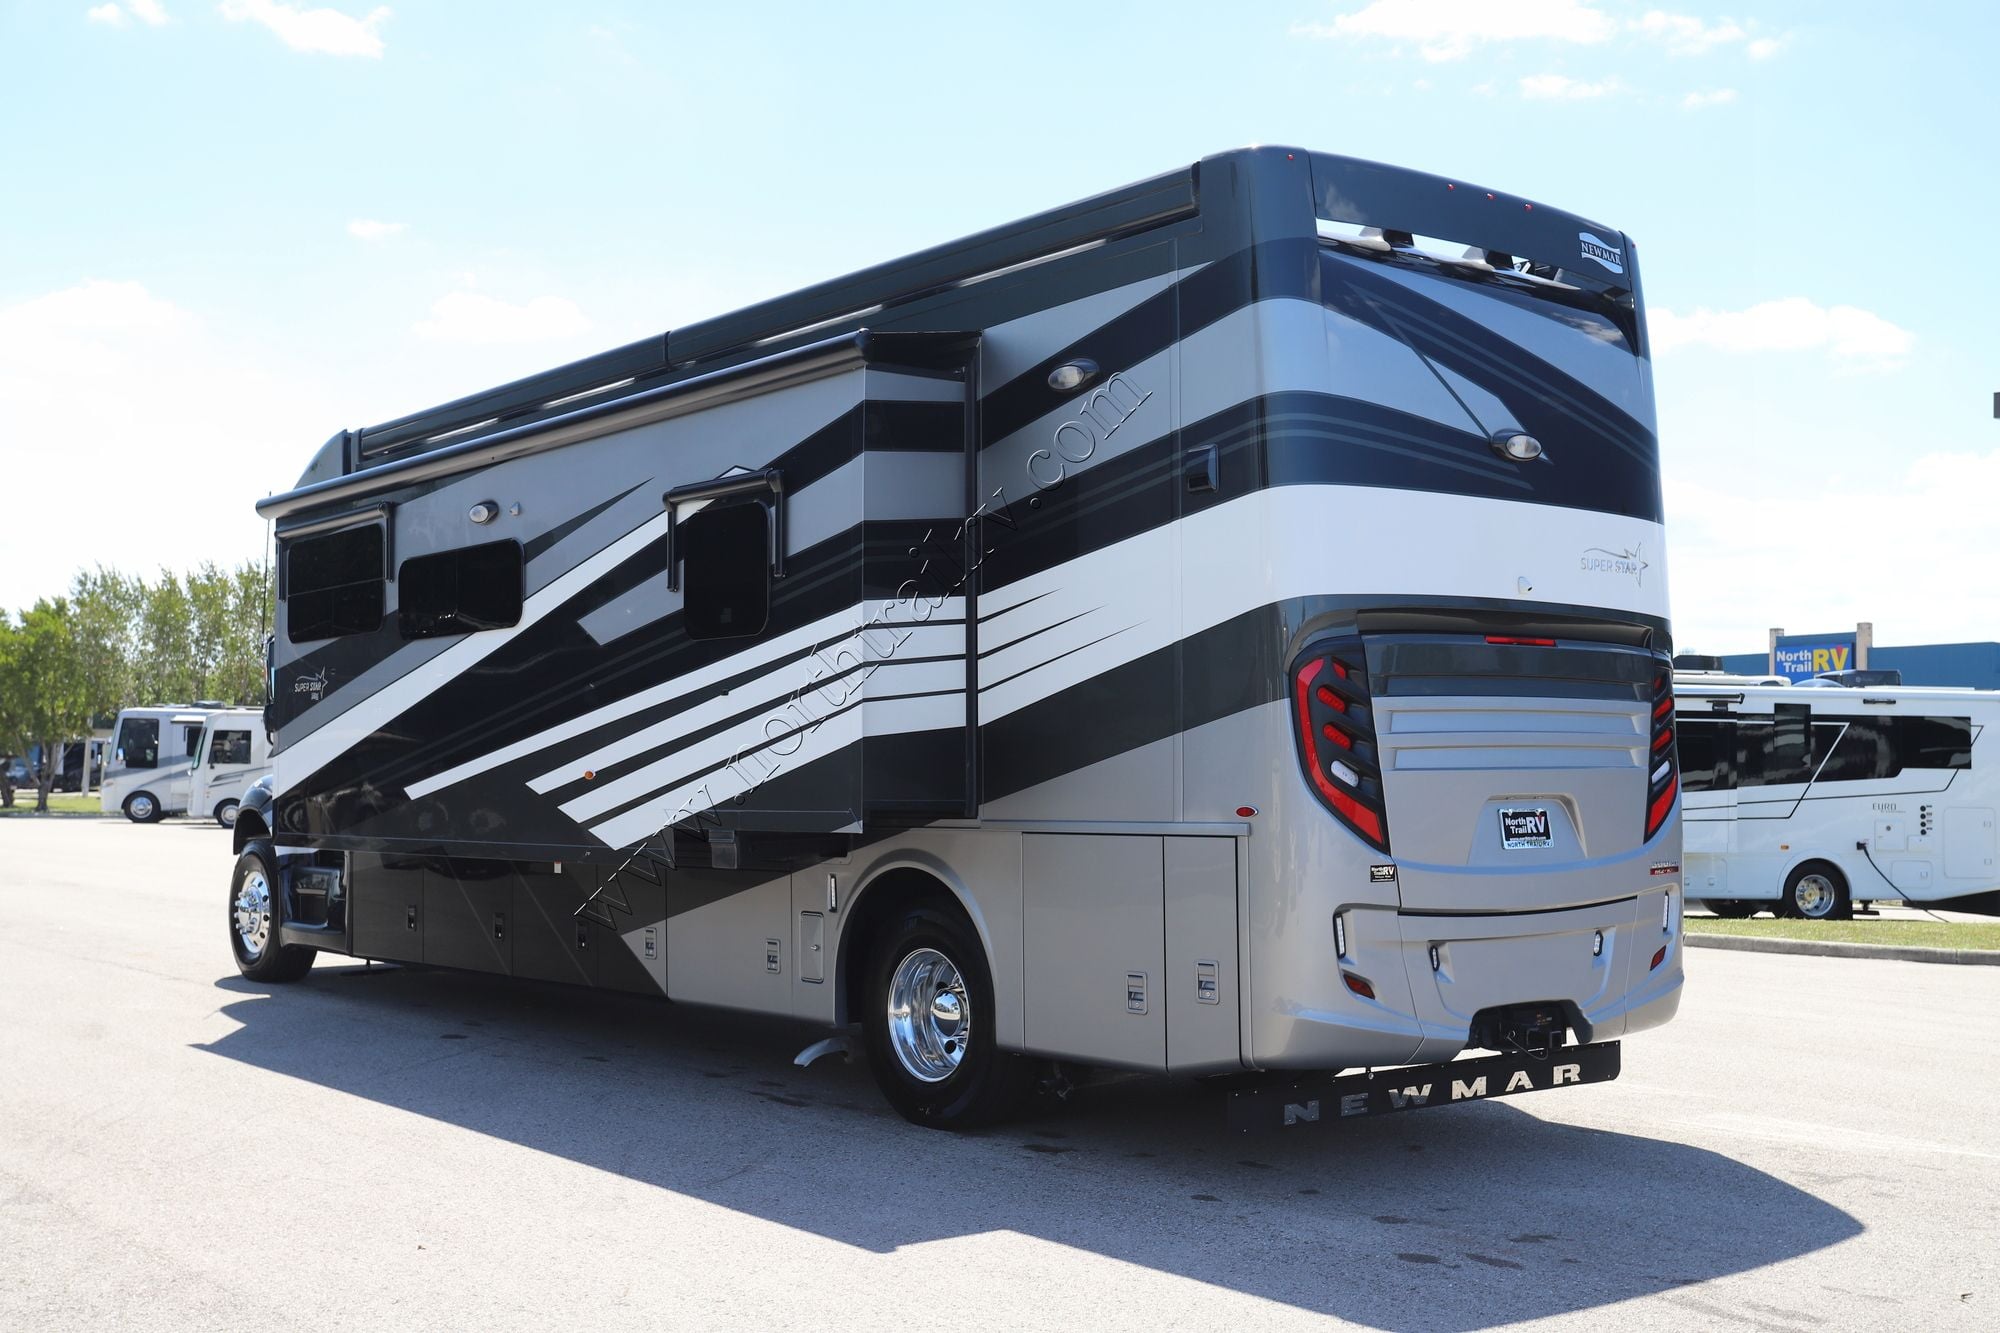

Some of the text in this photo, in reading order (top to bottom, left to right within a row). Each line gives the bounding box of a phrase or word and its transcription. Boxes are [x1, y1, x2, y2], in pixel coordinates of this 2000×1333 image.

[1581, 242, 1621, 266] NEWMAR
[1580, 558, 1637, 575] SUPER STAR
[1776, 648, 1848, 672] North RV
[1783, 661, 1812, 673] Trail
[1505, 816, 1545, 834] North RV
[1510, 825, 1527, 834] Trail
[1284, 1063, 1582, 1125] NEWMAR
